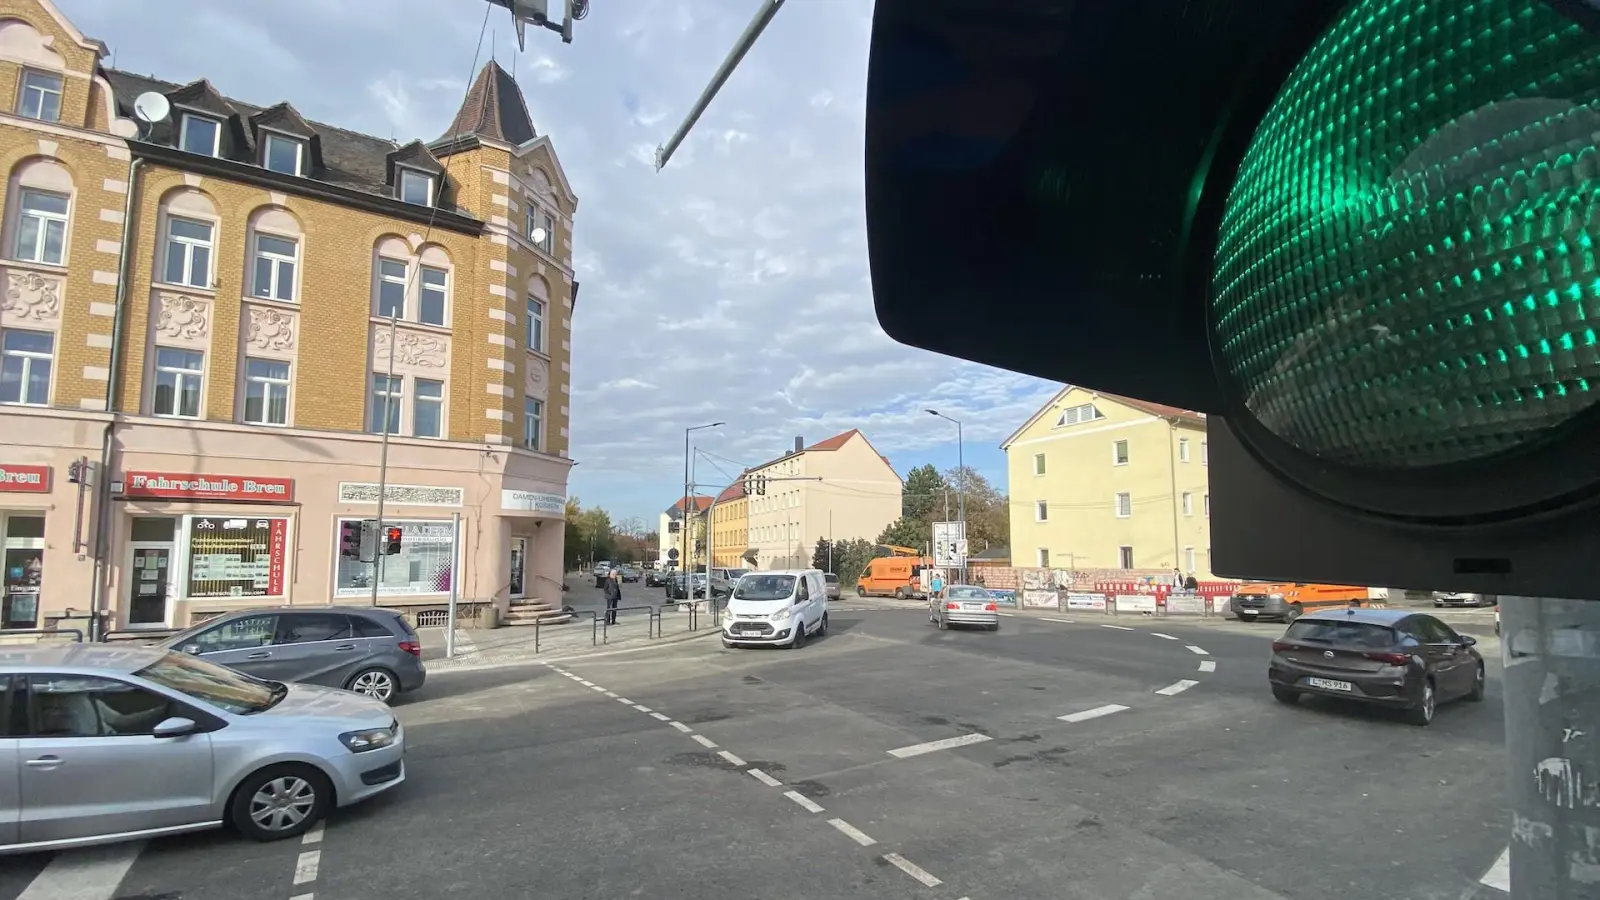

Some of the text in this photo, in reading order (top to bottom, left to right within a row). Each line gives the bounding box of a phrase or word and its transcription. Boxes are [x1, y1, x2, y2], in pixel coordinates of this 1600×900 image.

[132, 475, 286, 495] Fahrschule Breu
[273, 521, 283, 593] FAHRSCHULE
